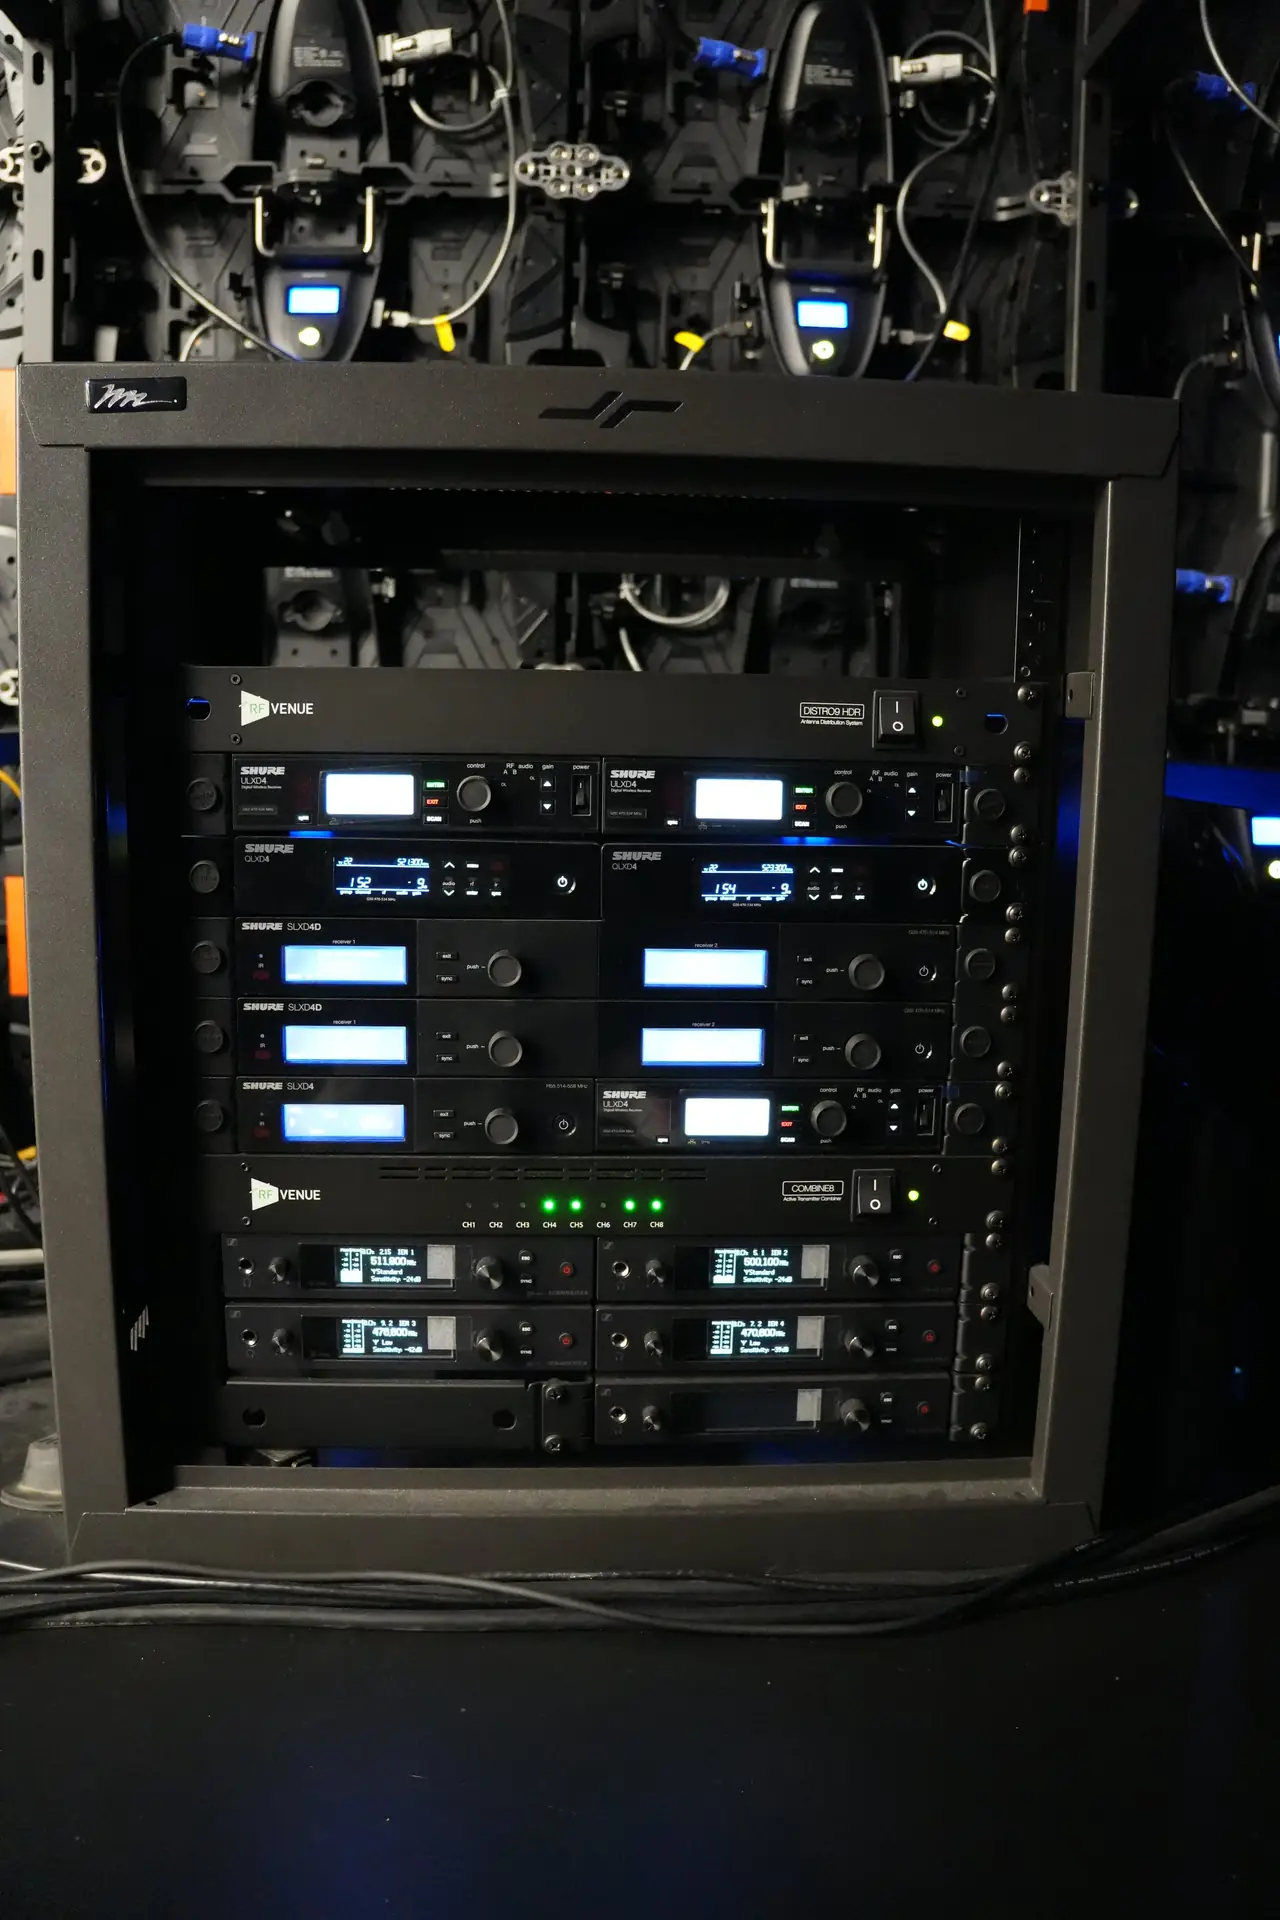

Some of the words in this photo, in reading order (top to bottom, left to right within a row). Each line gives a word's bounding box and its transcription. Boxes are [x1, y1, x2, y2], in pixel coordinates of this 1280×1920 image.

[250, 704, 264, 714] RF
[271, 703, 314, 714] VENUE
[804, 706, 840, 715] DISTRO9
[842, 708, 861, 716] HDR
[240, 766, 286, 775] SHURE
[610, 770, 655, 779] SHURE
[240, 777, 267, 785] ULXD4
[245, 844, 294, 854] SHURE
[612, 851, 662, 861] SHURE
[612, 863, 637, 871] QLXD4
[241, 922, 283, 931] SHURE
[287, 922, 322, 931] SLXD4D
[243, 1003, 284, 1012] SHURE
[288, 1003, 322, 1012] SLXD4D
[242, 1082, 283, 1091] SHURE
[287, 1082, 314, 1090] SLXD4
[602, 1091, 647, 1099] SHURE
[791, 1184, 834, 1192] COMBINE8
[259, 1190, 272, 1199] RF
[280, 1189, 321, 1200] VENUE
